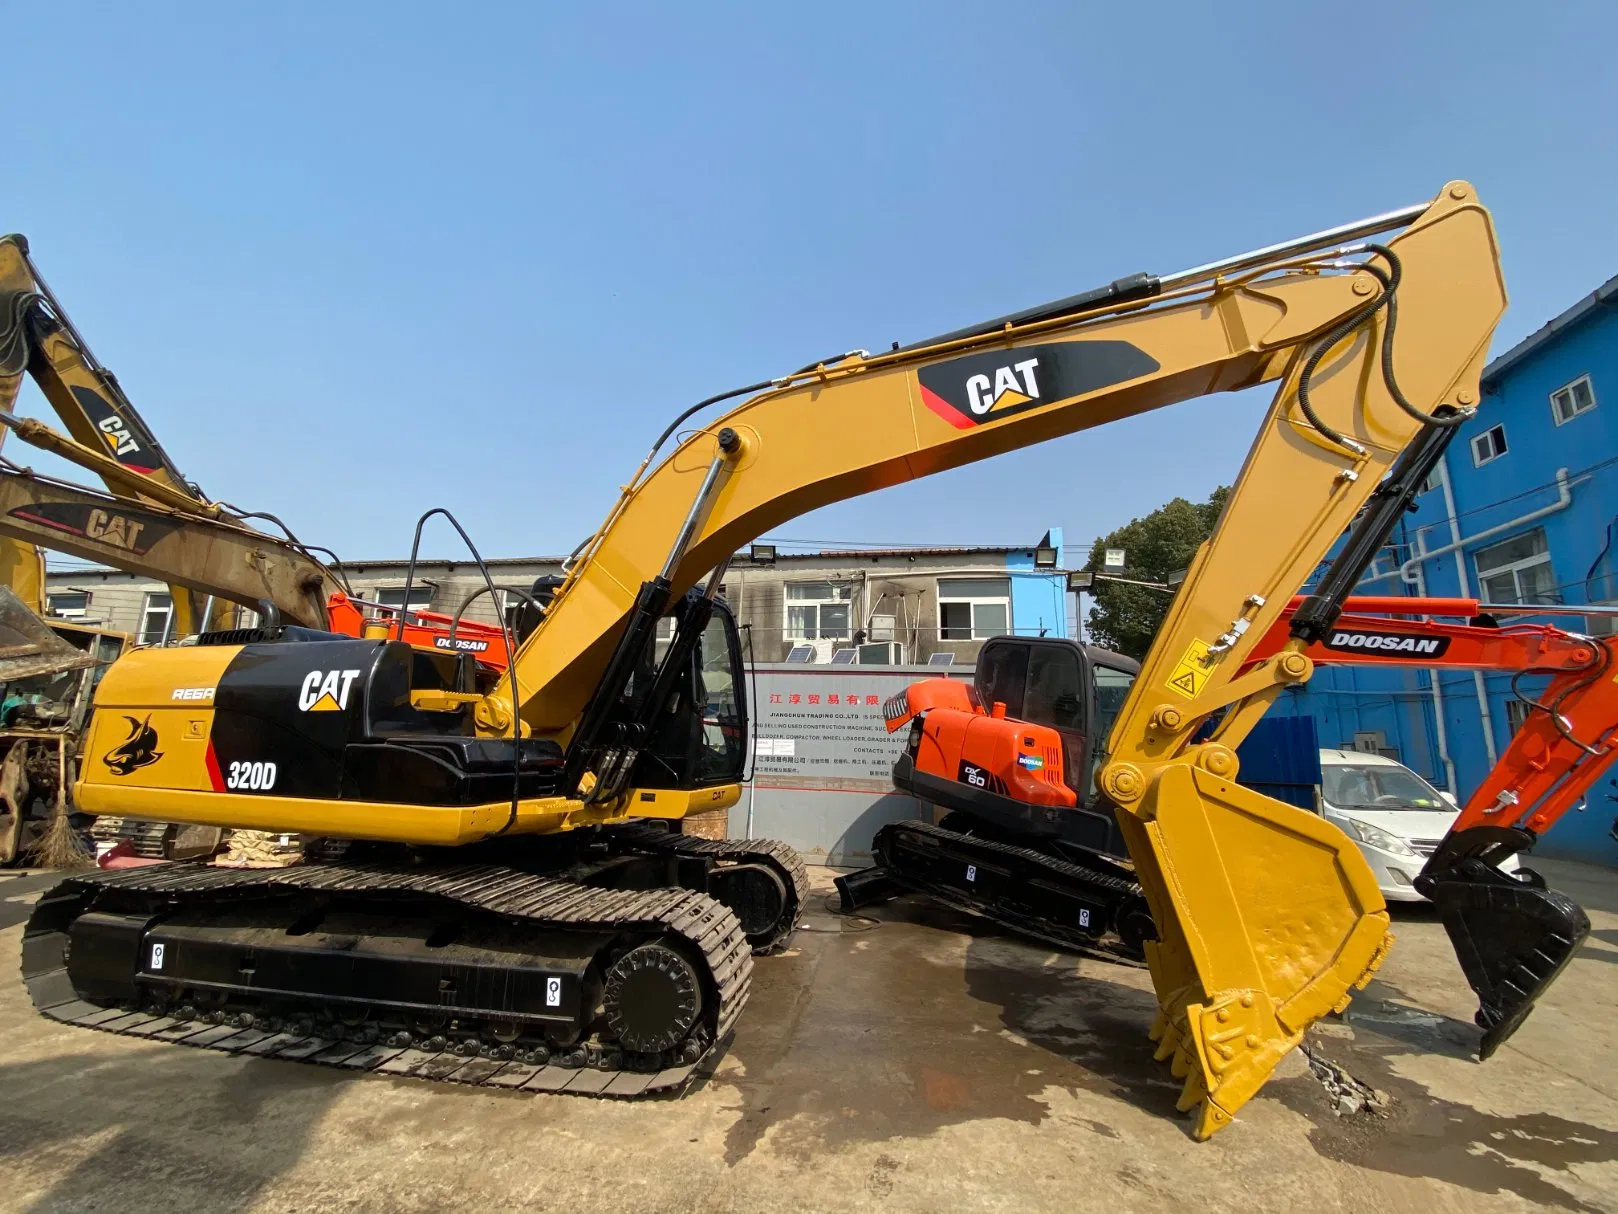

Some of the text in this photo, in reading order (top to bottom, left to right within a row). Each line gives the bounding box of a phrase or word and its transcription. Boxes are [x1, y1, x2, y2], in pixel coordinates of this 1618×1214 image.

[966, 357, 1040, 415] CAT
[98, 415, 141, 456] CAT
[85, 508, 145, 550] CAT
[1330, 633, 1440, 653] DOOSAN
[298, 669, 361, 712] CAT
[964, 766, 982, 776] DX
[1018, 757, 1043, 767] DOOSAN
[227, 761, 277, 790] 320D
[968, 774, 985, 787] 60
[712, 790, 726, 801] CAT
